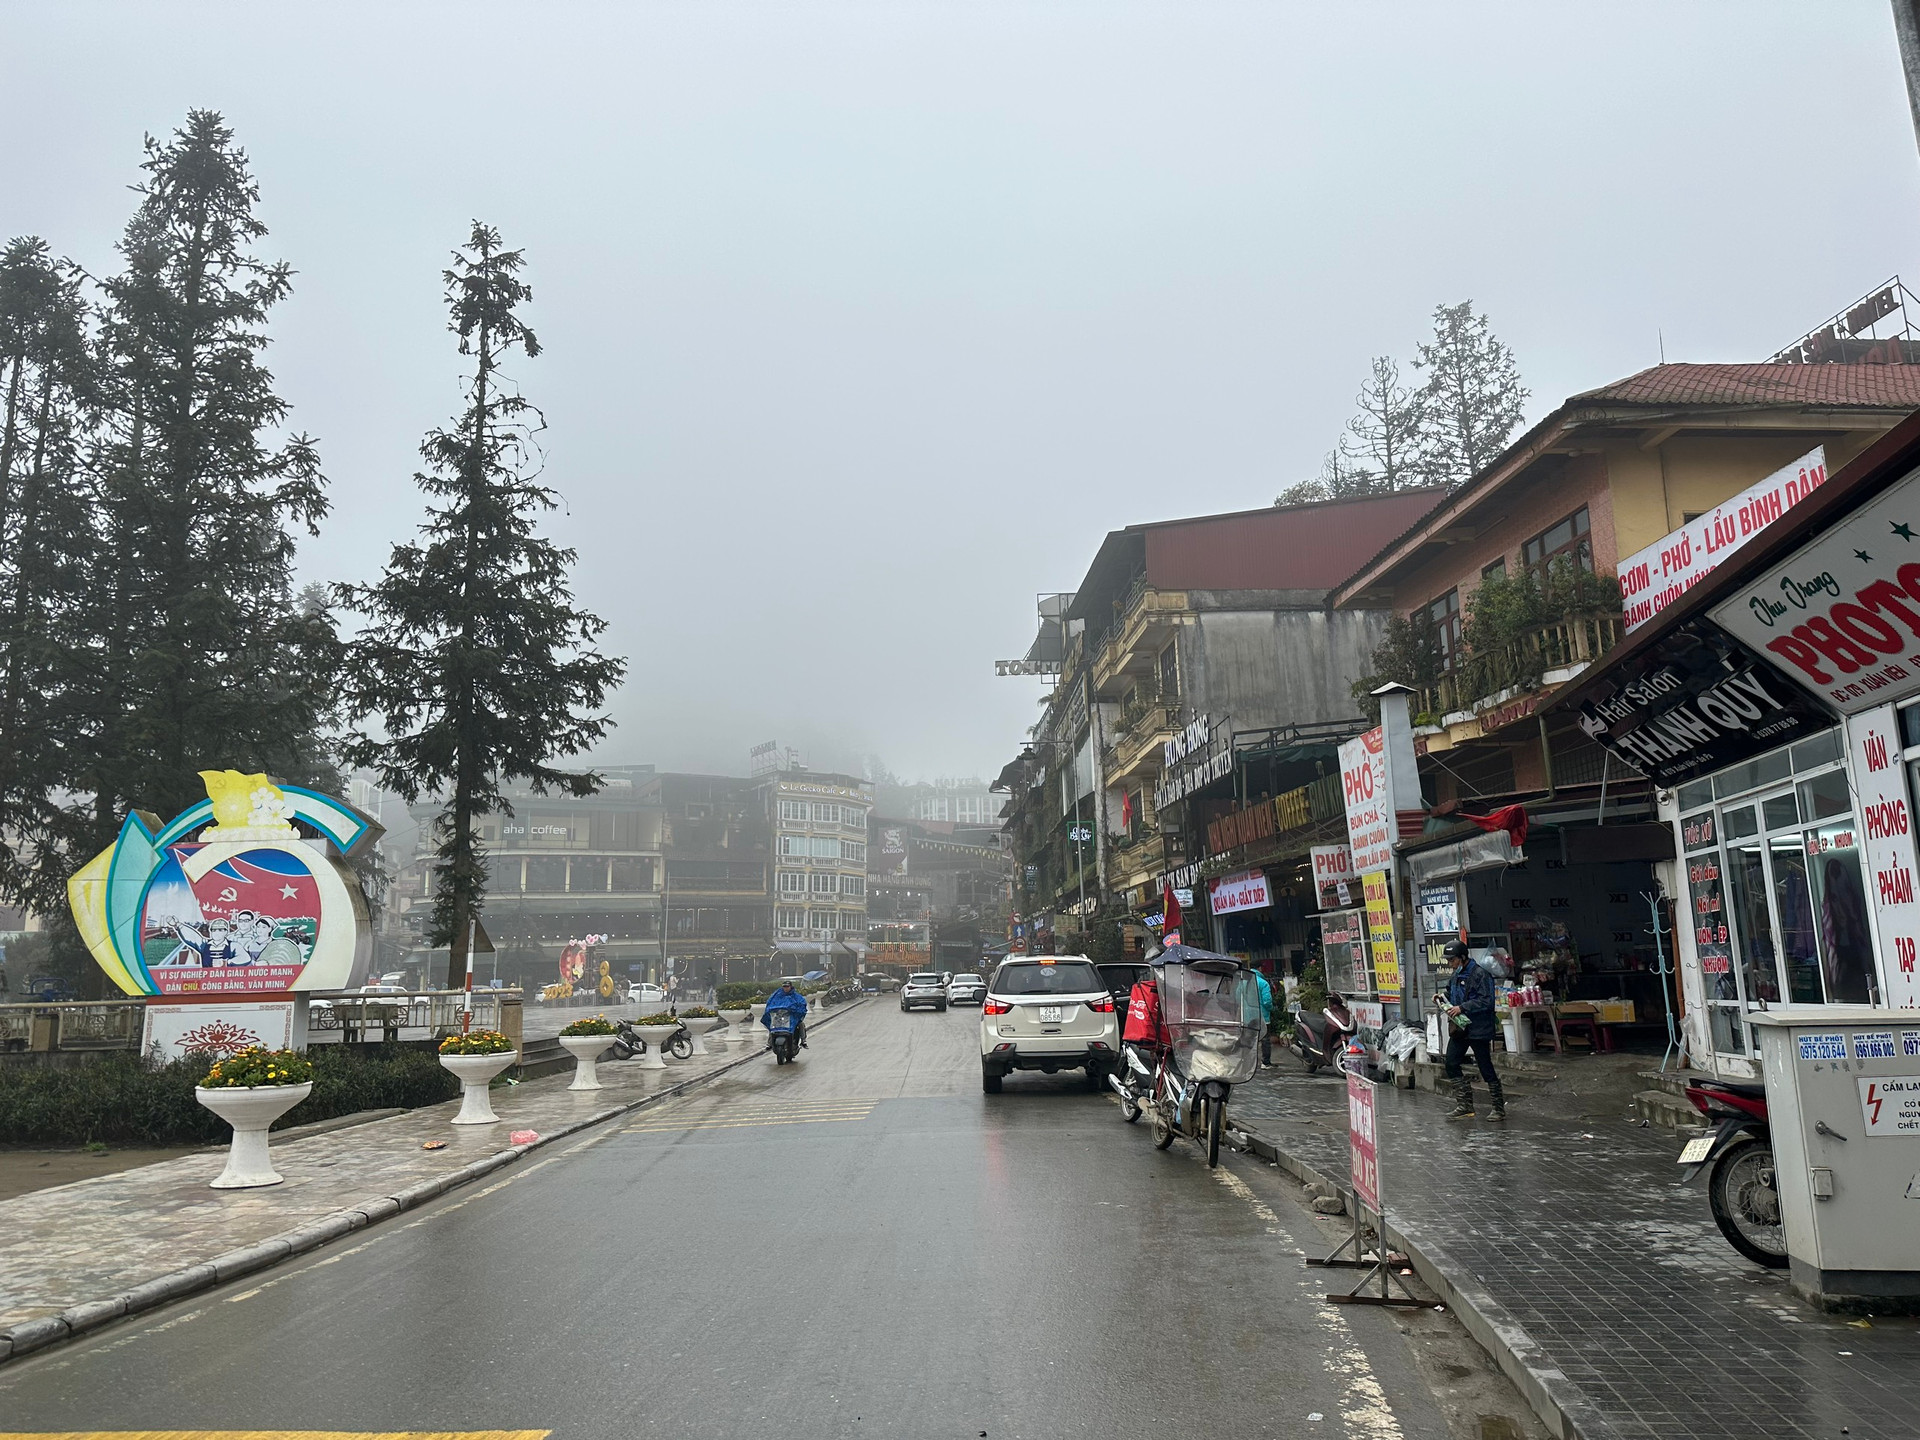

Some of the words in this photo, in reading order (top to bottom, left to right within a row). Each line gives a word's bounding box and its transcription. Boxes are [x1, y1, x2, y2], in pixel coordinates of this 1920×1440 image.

[1619, 562, 1650, 600] CƠM
[1661, 531, 1692, 578] PHỞ
[1704, 509, 1736, 555] LẨU
[1739, 497, 1783, 537] BÌNH
[1623, 603, 1652, 628] BÁNH
[1595, 697, 1636, 724] Hair
[1625, 672, 1682, 706] Salon
[1616, 706, 1720, 766] THANH
[1697, 660, 1784, 731] QUÝ
[1863, 730, 1887, 773] VĂN
[1344, 749, 1374, 807] PHỞ
[503, 823, 525, 834] aha
[531, 824, 567, 835] coffee
[1865, 793, 1908, 840] PHÒNG
[1684, 821, 1699, 846] TÓC
[1316, 845, 1348, 874] PHỞ
[1156, 872, 1176, 896] KHCH
[1895, 937, 1916, 983] TẠP
[544, 983, 573, 1000] 2023
[1800, 1045, 1846, 1059] 0975.120.644
[1903, 1039, 1920, 1055] 097
[1882, 1080, 1904, 1091] CẤM
[1904, 1099, 1916, 1108] CÓ
[1897, 1119, 1919, 1129] CHẾT
